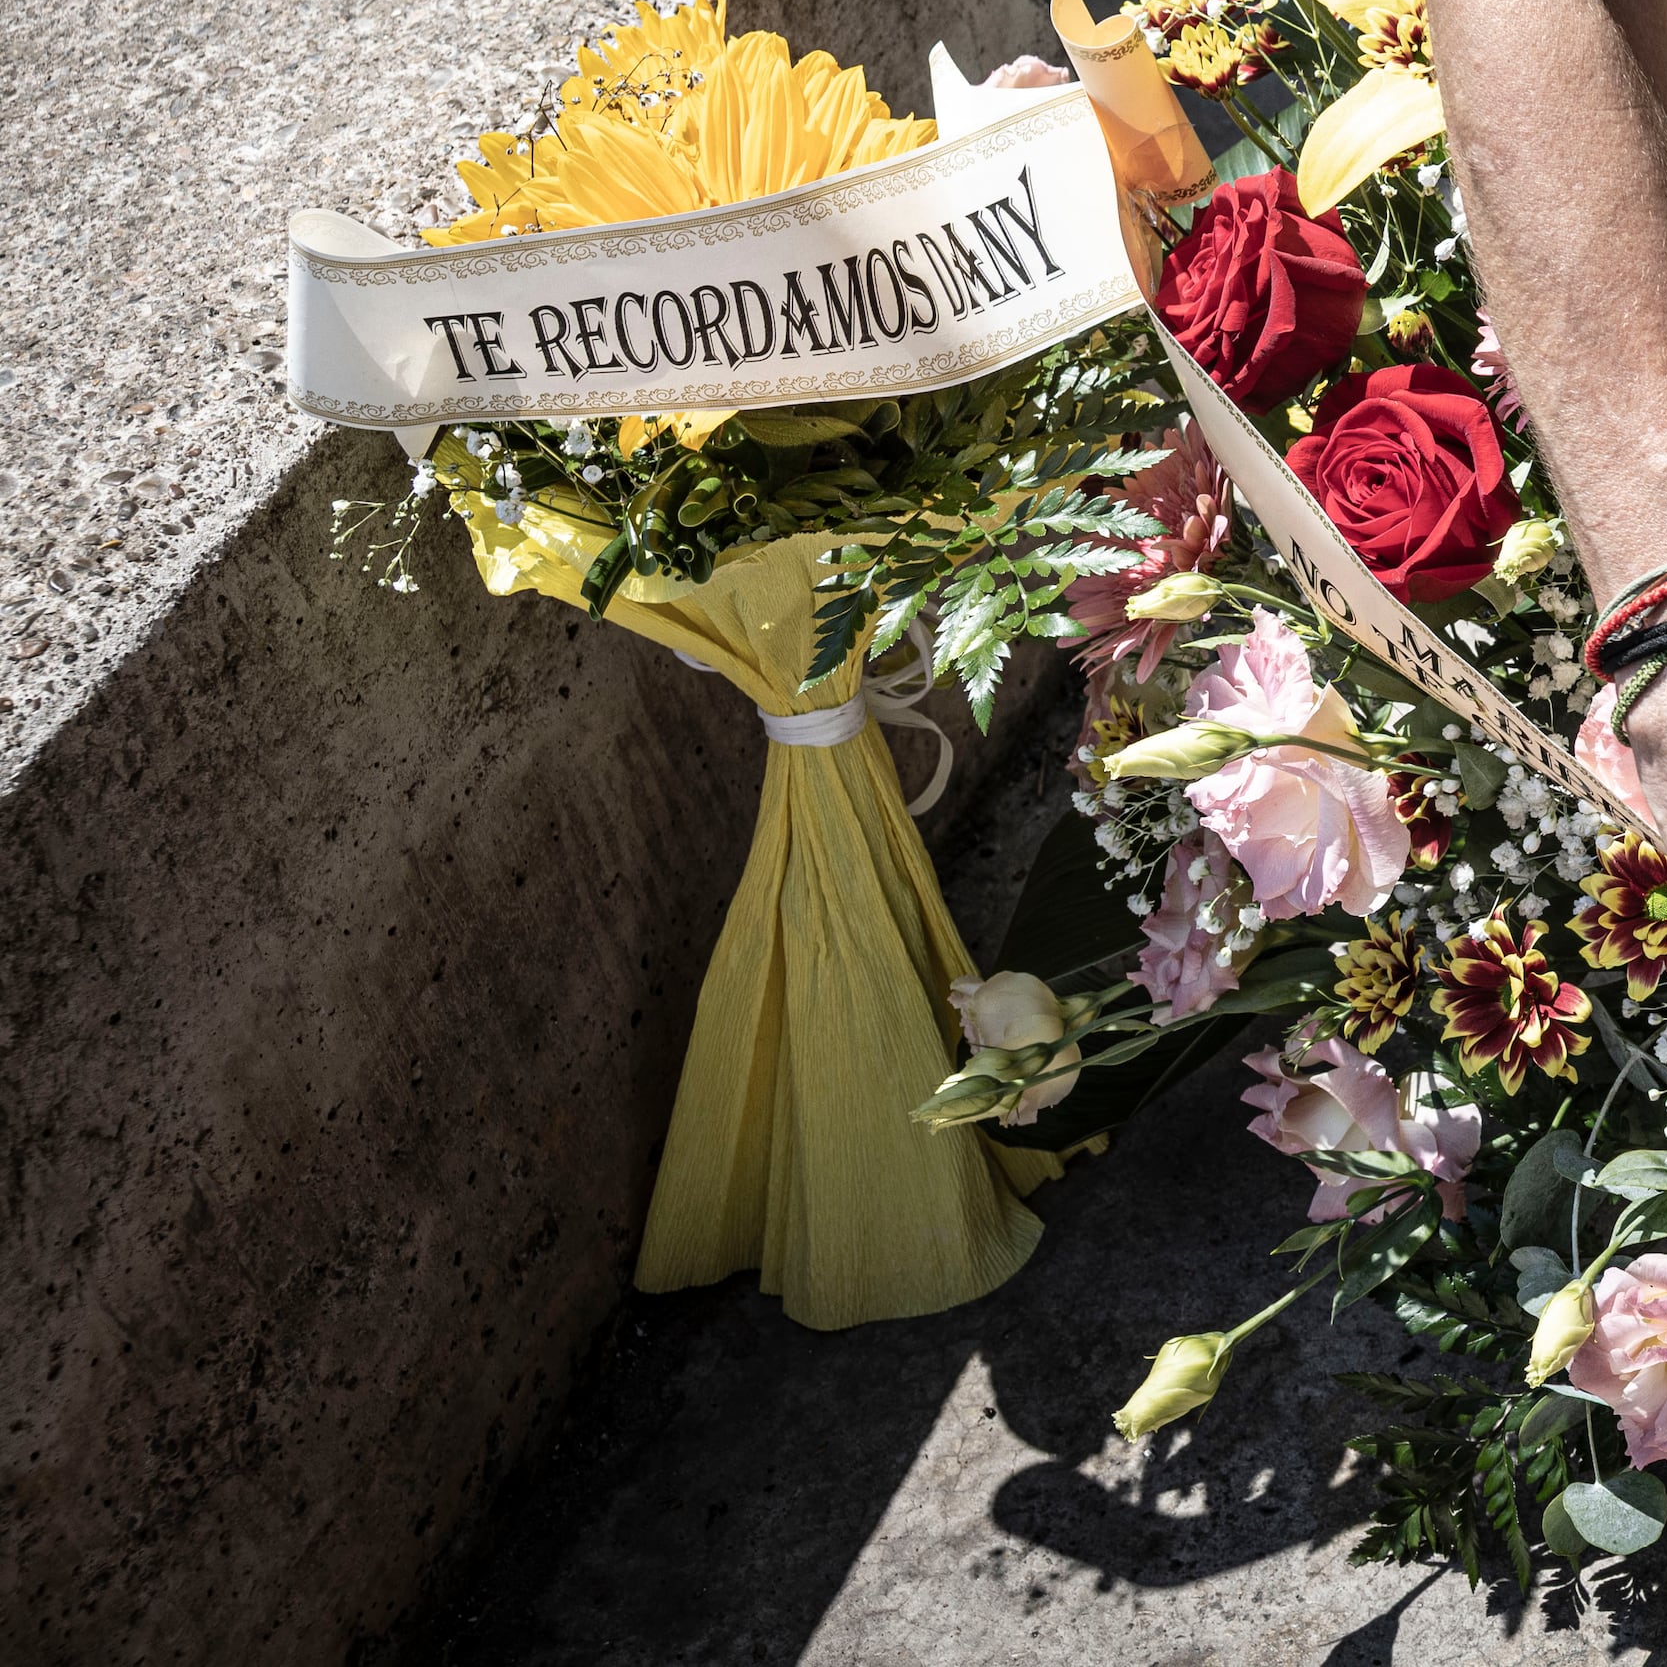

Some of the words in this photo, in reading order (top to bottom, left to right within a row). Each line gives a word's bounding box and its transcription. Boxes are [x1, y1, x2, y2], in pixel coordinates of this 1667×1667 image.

[423, 310, 525, 383] TE
[528, 239, 940, 380] RECORDAMOS
[915, 163, 1066, 322] DANY
[1289, 536, 1357, 626] NO
